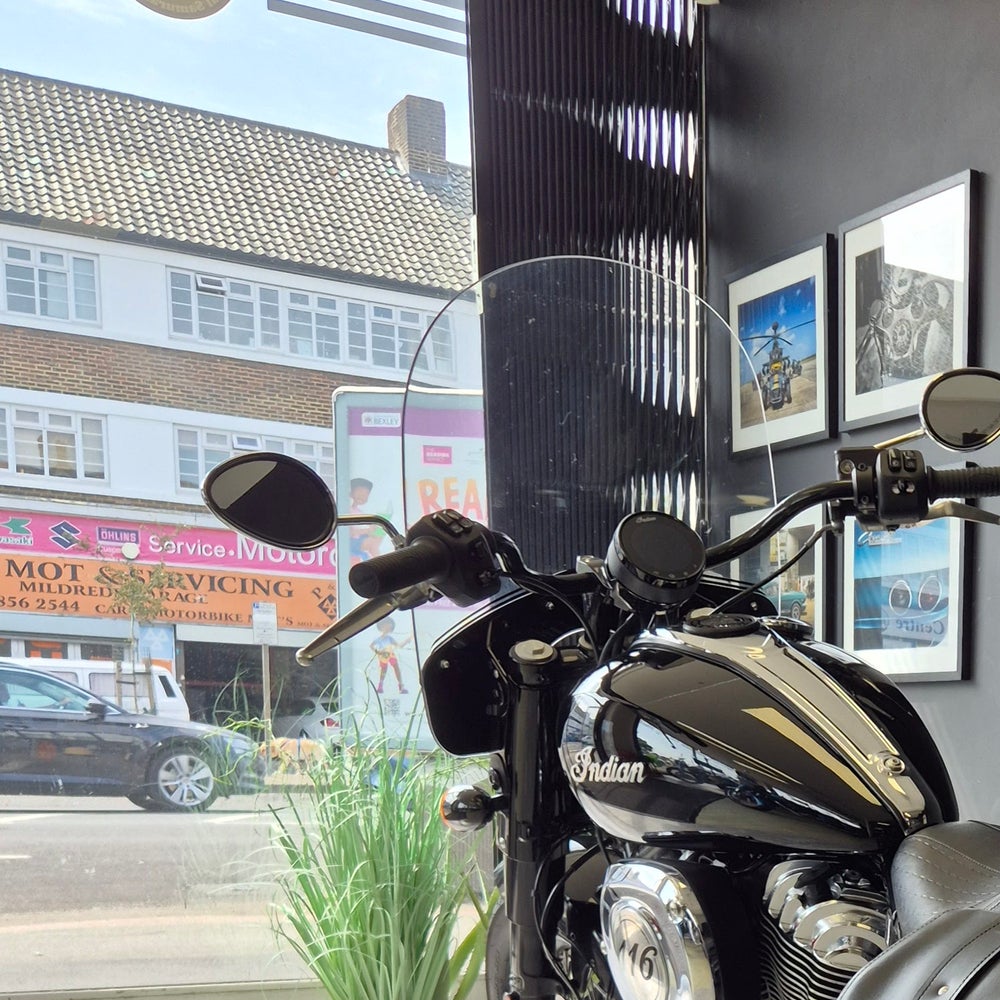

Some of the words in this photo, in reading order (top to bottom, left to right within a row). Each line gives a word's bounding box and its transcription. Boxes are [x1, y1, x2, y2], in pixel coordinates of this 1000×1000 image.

[101, 528, 137, 542] ÖHLINS
[149, 535, 226, 558] Service
[5, 558, 84, 582] MOT
[36, 598, 80, 611] 2544
[95, 604, 128, 615] CAR
[571, 746, 645, 784] Indian
